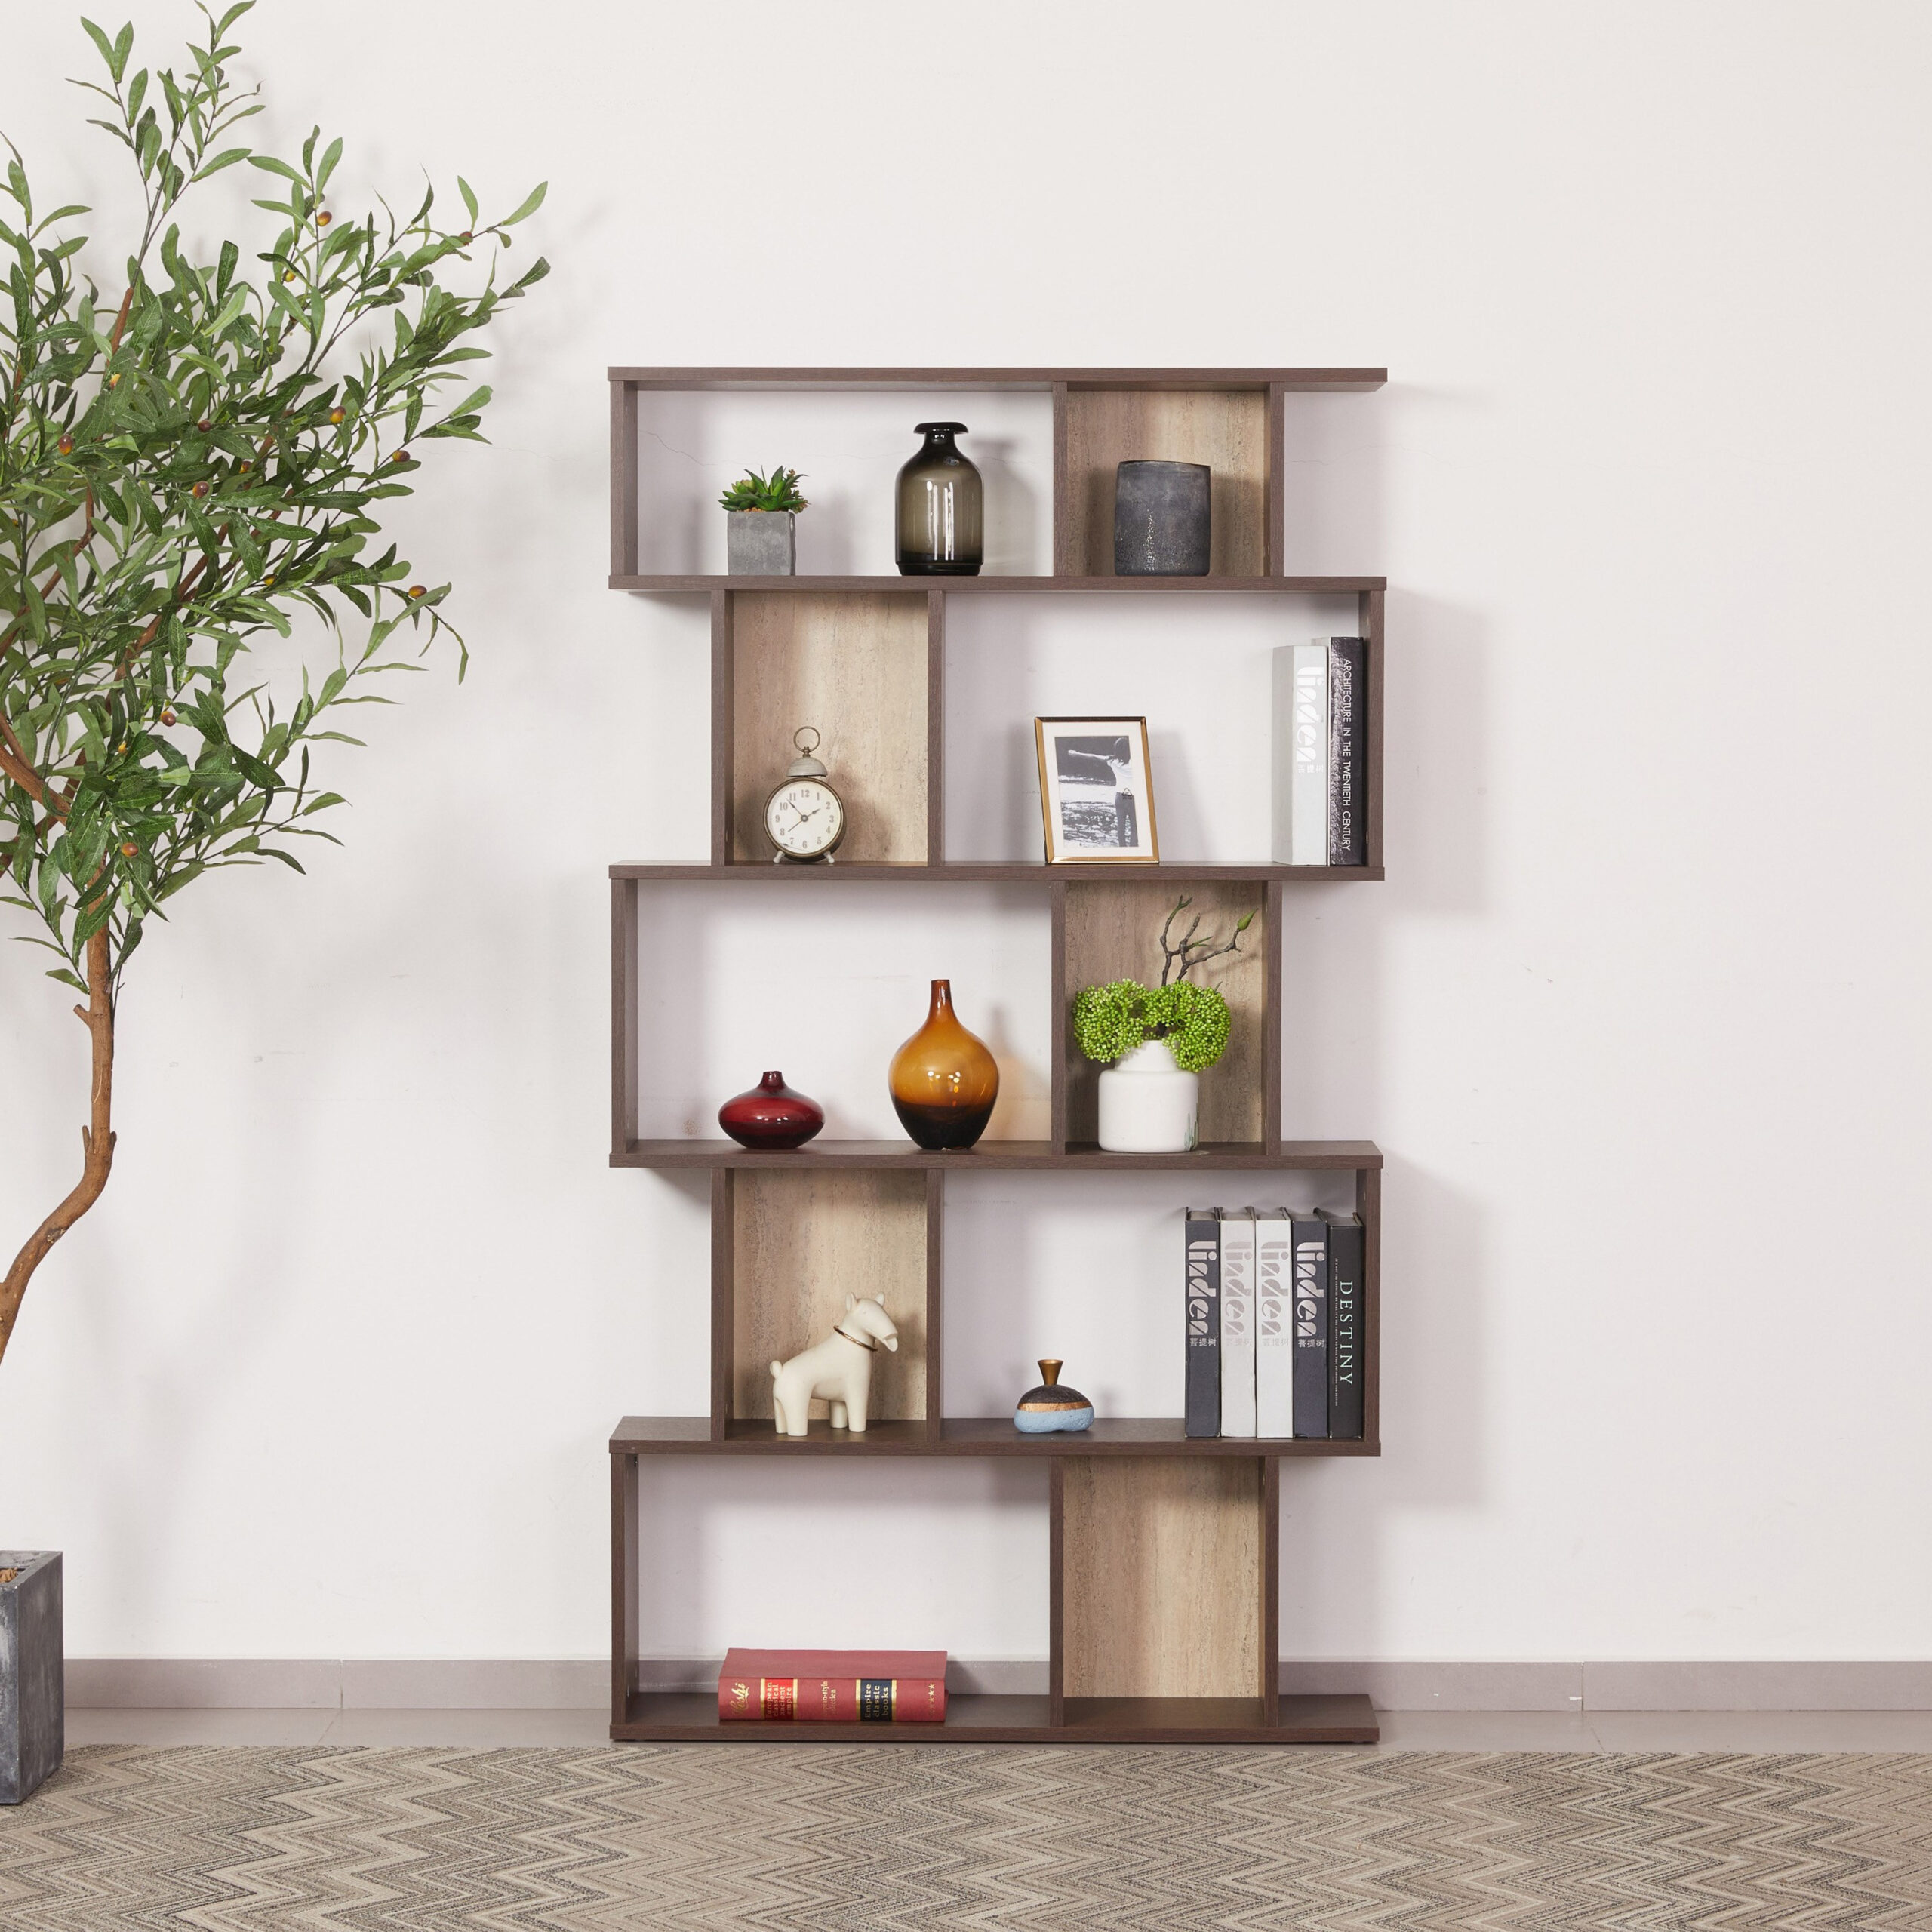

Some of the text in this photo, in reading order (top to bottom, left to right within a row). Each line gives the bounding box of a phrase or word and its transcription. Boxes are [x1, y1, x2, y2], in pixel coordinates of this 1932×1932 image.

[1296, 666, 1325, 762] linden
[1342, 658, 1352, 851] ARCHITECTURE IN THE TWENTIETH CENTURY
[789, 792, 796, 801] 11
[801, 789, 810, 798] 12
[817, 792, 820, 801] 1
[779, 801, 788, 811] 10
[826, 801, 831, 810] 2
[775, 814, 780, 823] 9
[829, 814, 835, 823] 3
[780, 828, 785, 836] 8
[826, 826, 831, 834] 4
[789, 837, 795, 845] 7
[802, 840, 808, 848] 6
[817, 836, 822, 844] 5
[1188, 1241, 1217, 1336] linden
[1224, 1241, 1253, 1336] linden
[1260, 1241, 1289, 1336] linden
[1296, 1241, 1325, 1337] linden
[1339, 1281, 1353, 1385] DESTINY
[864, 1684, 873, 1718] Empire
[881, 1687, 889, 1715] books
